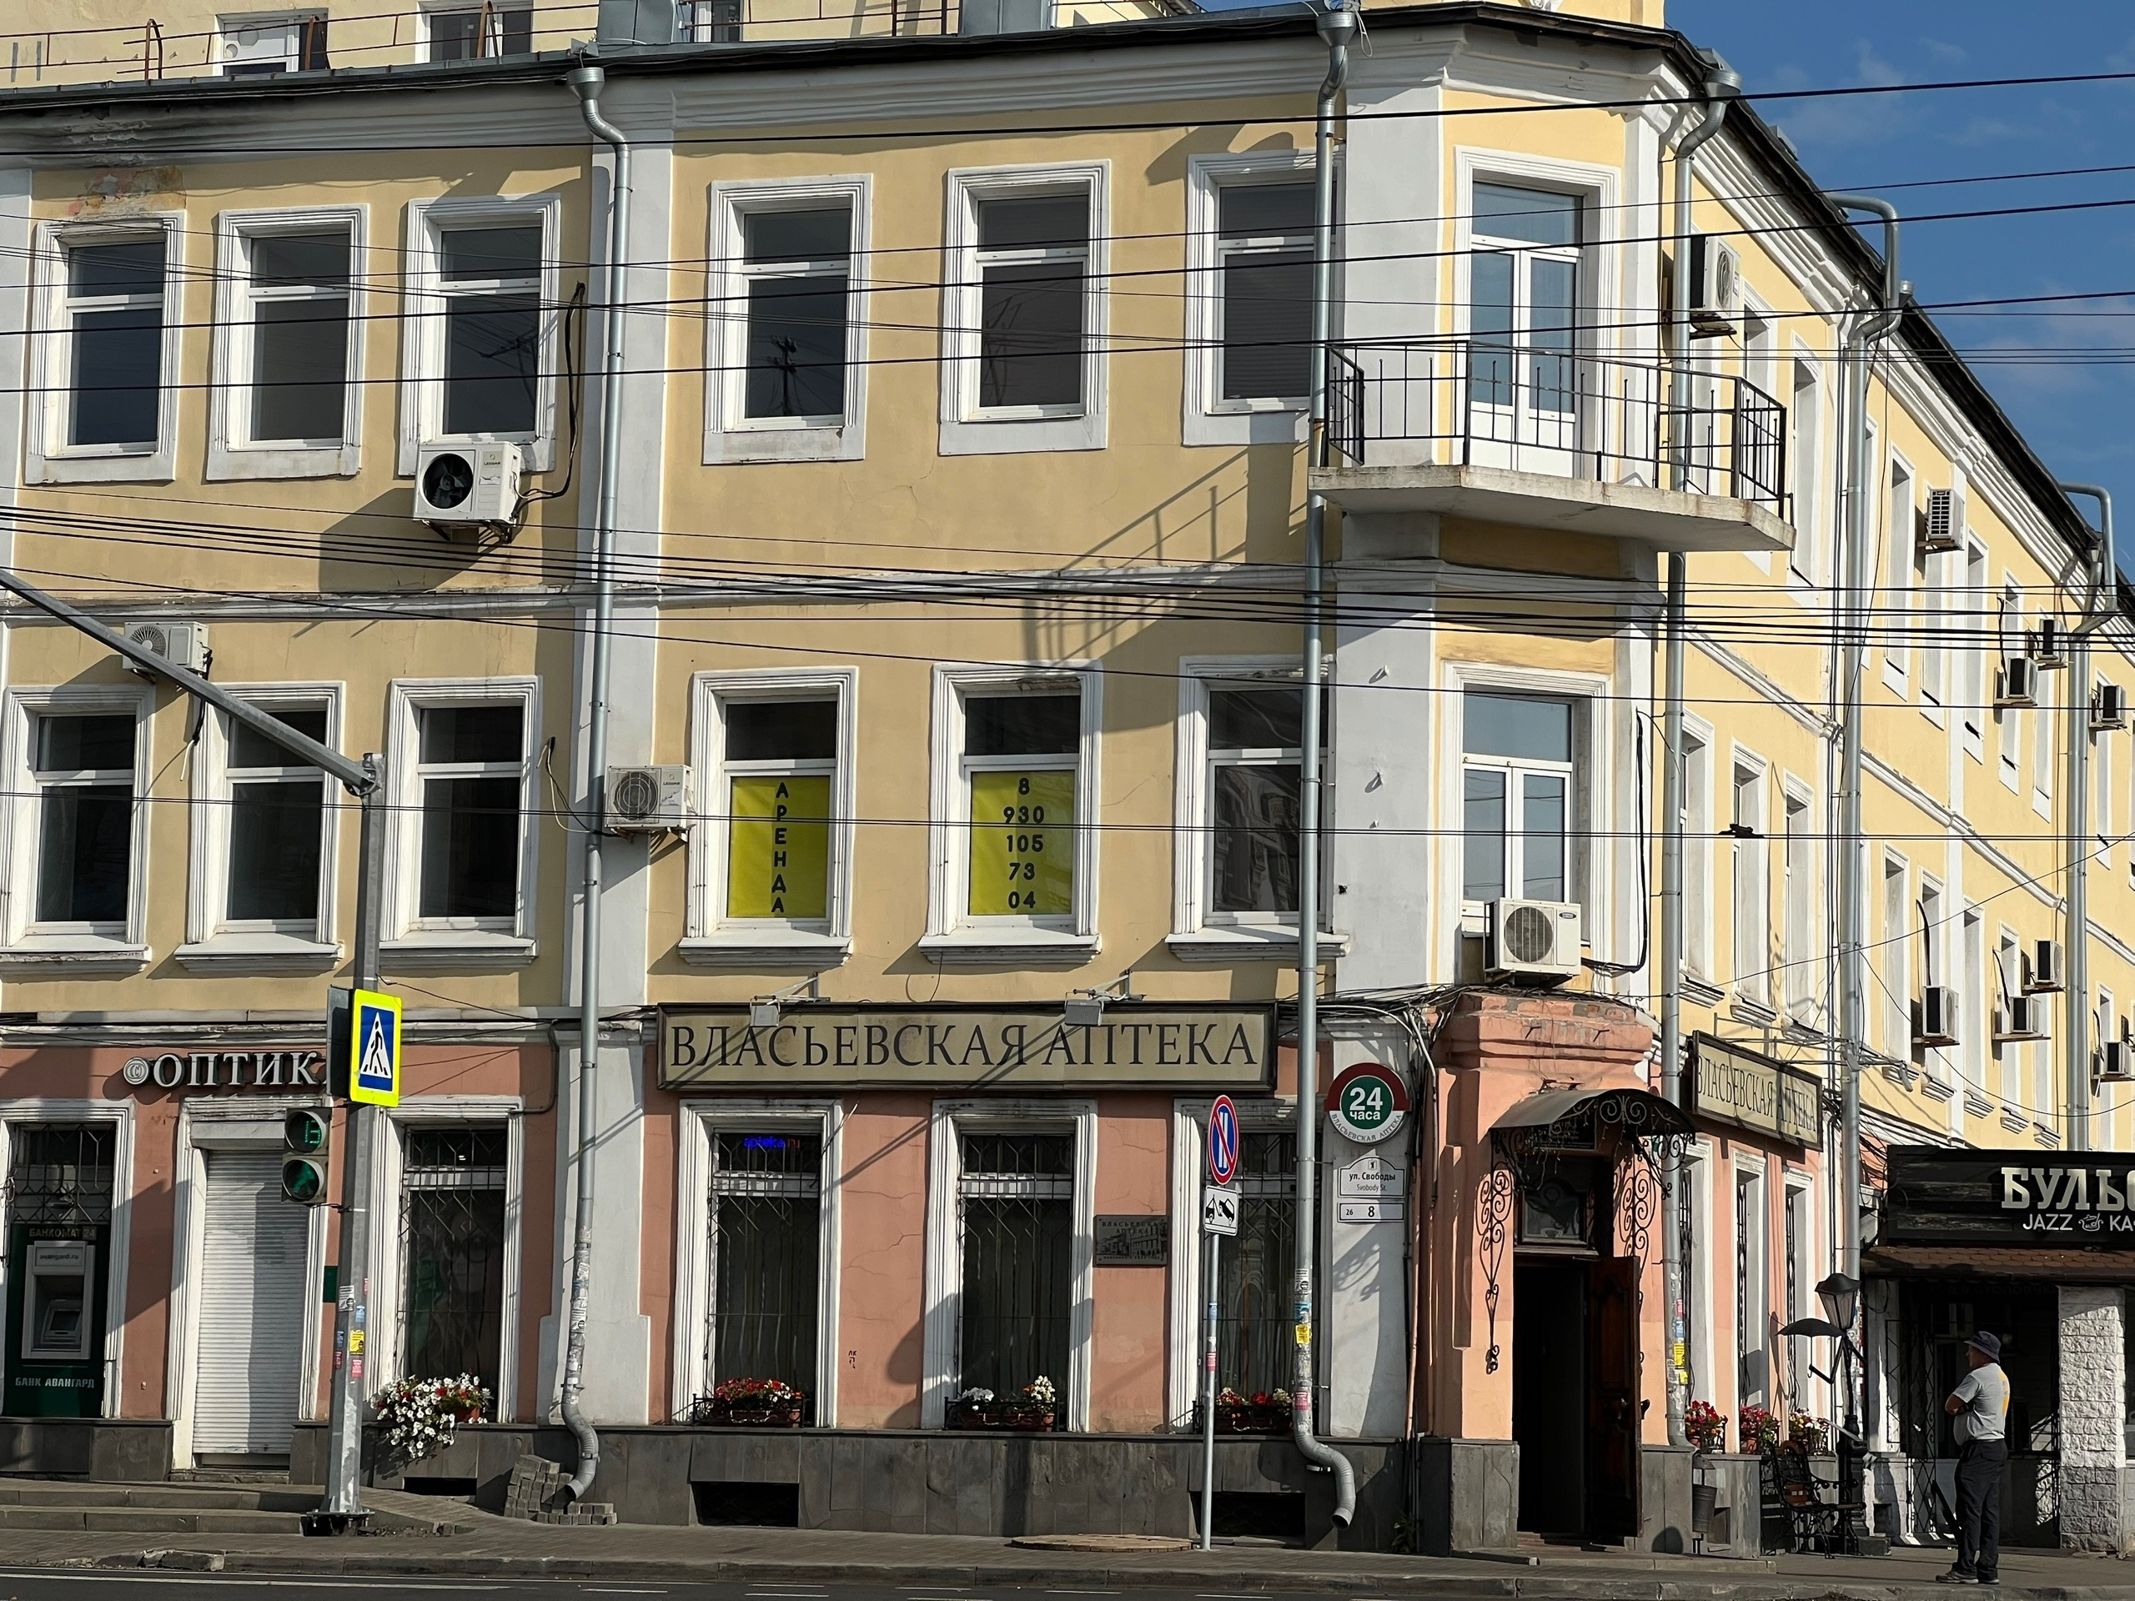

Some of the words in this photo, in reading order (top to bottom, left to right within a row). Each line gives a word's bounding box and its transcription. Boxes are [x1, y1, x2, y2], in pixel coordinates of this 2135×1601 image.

[1018, 777, 1030, 795] 8
[1003, 805, 1045, 824] 930
[771, 782, 789, 913] АРЕНДА
[1006, 834, 1044, 852] 105
[1009, 862, 1035, 881] 73
[1008, 891, 1036, 909] 04
[671, 1024, 1028, 1067] ВЛАСЬЕВСКАЯ
[1041, 1022, 1258, 1066] АПТЕКА
[153, 1052, 327, 1088] ОПТИК
[1698, 1054, 1774, 1118] ВЛАСЬЕВСКАЯ
[1349, 1087, 1383, 1111] 24
[1349, 1111, 1381, 1120] часа
[1332, 1114, 1377, 1141] ВЛАСЬЕВСКАЯ
[1349, 1173, 1360, 1182] ул.
[1362, 1172, 1396, 1182] Свободы
[1368, 1206, 1375, 1217] 8
[2022, 1213, 2073, 1231] JAZZ
[2109, 1215, 2135, 1231] КА
[29, 1227, 81, 1238] БАНКОМАТ
[15, 1377, 41, 1387] БАНК
[45, 1378, 95, 1389] АВАНГАРД
